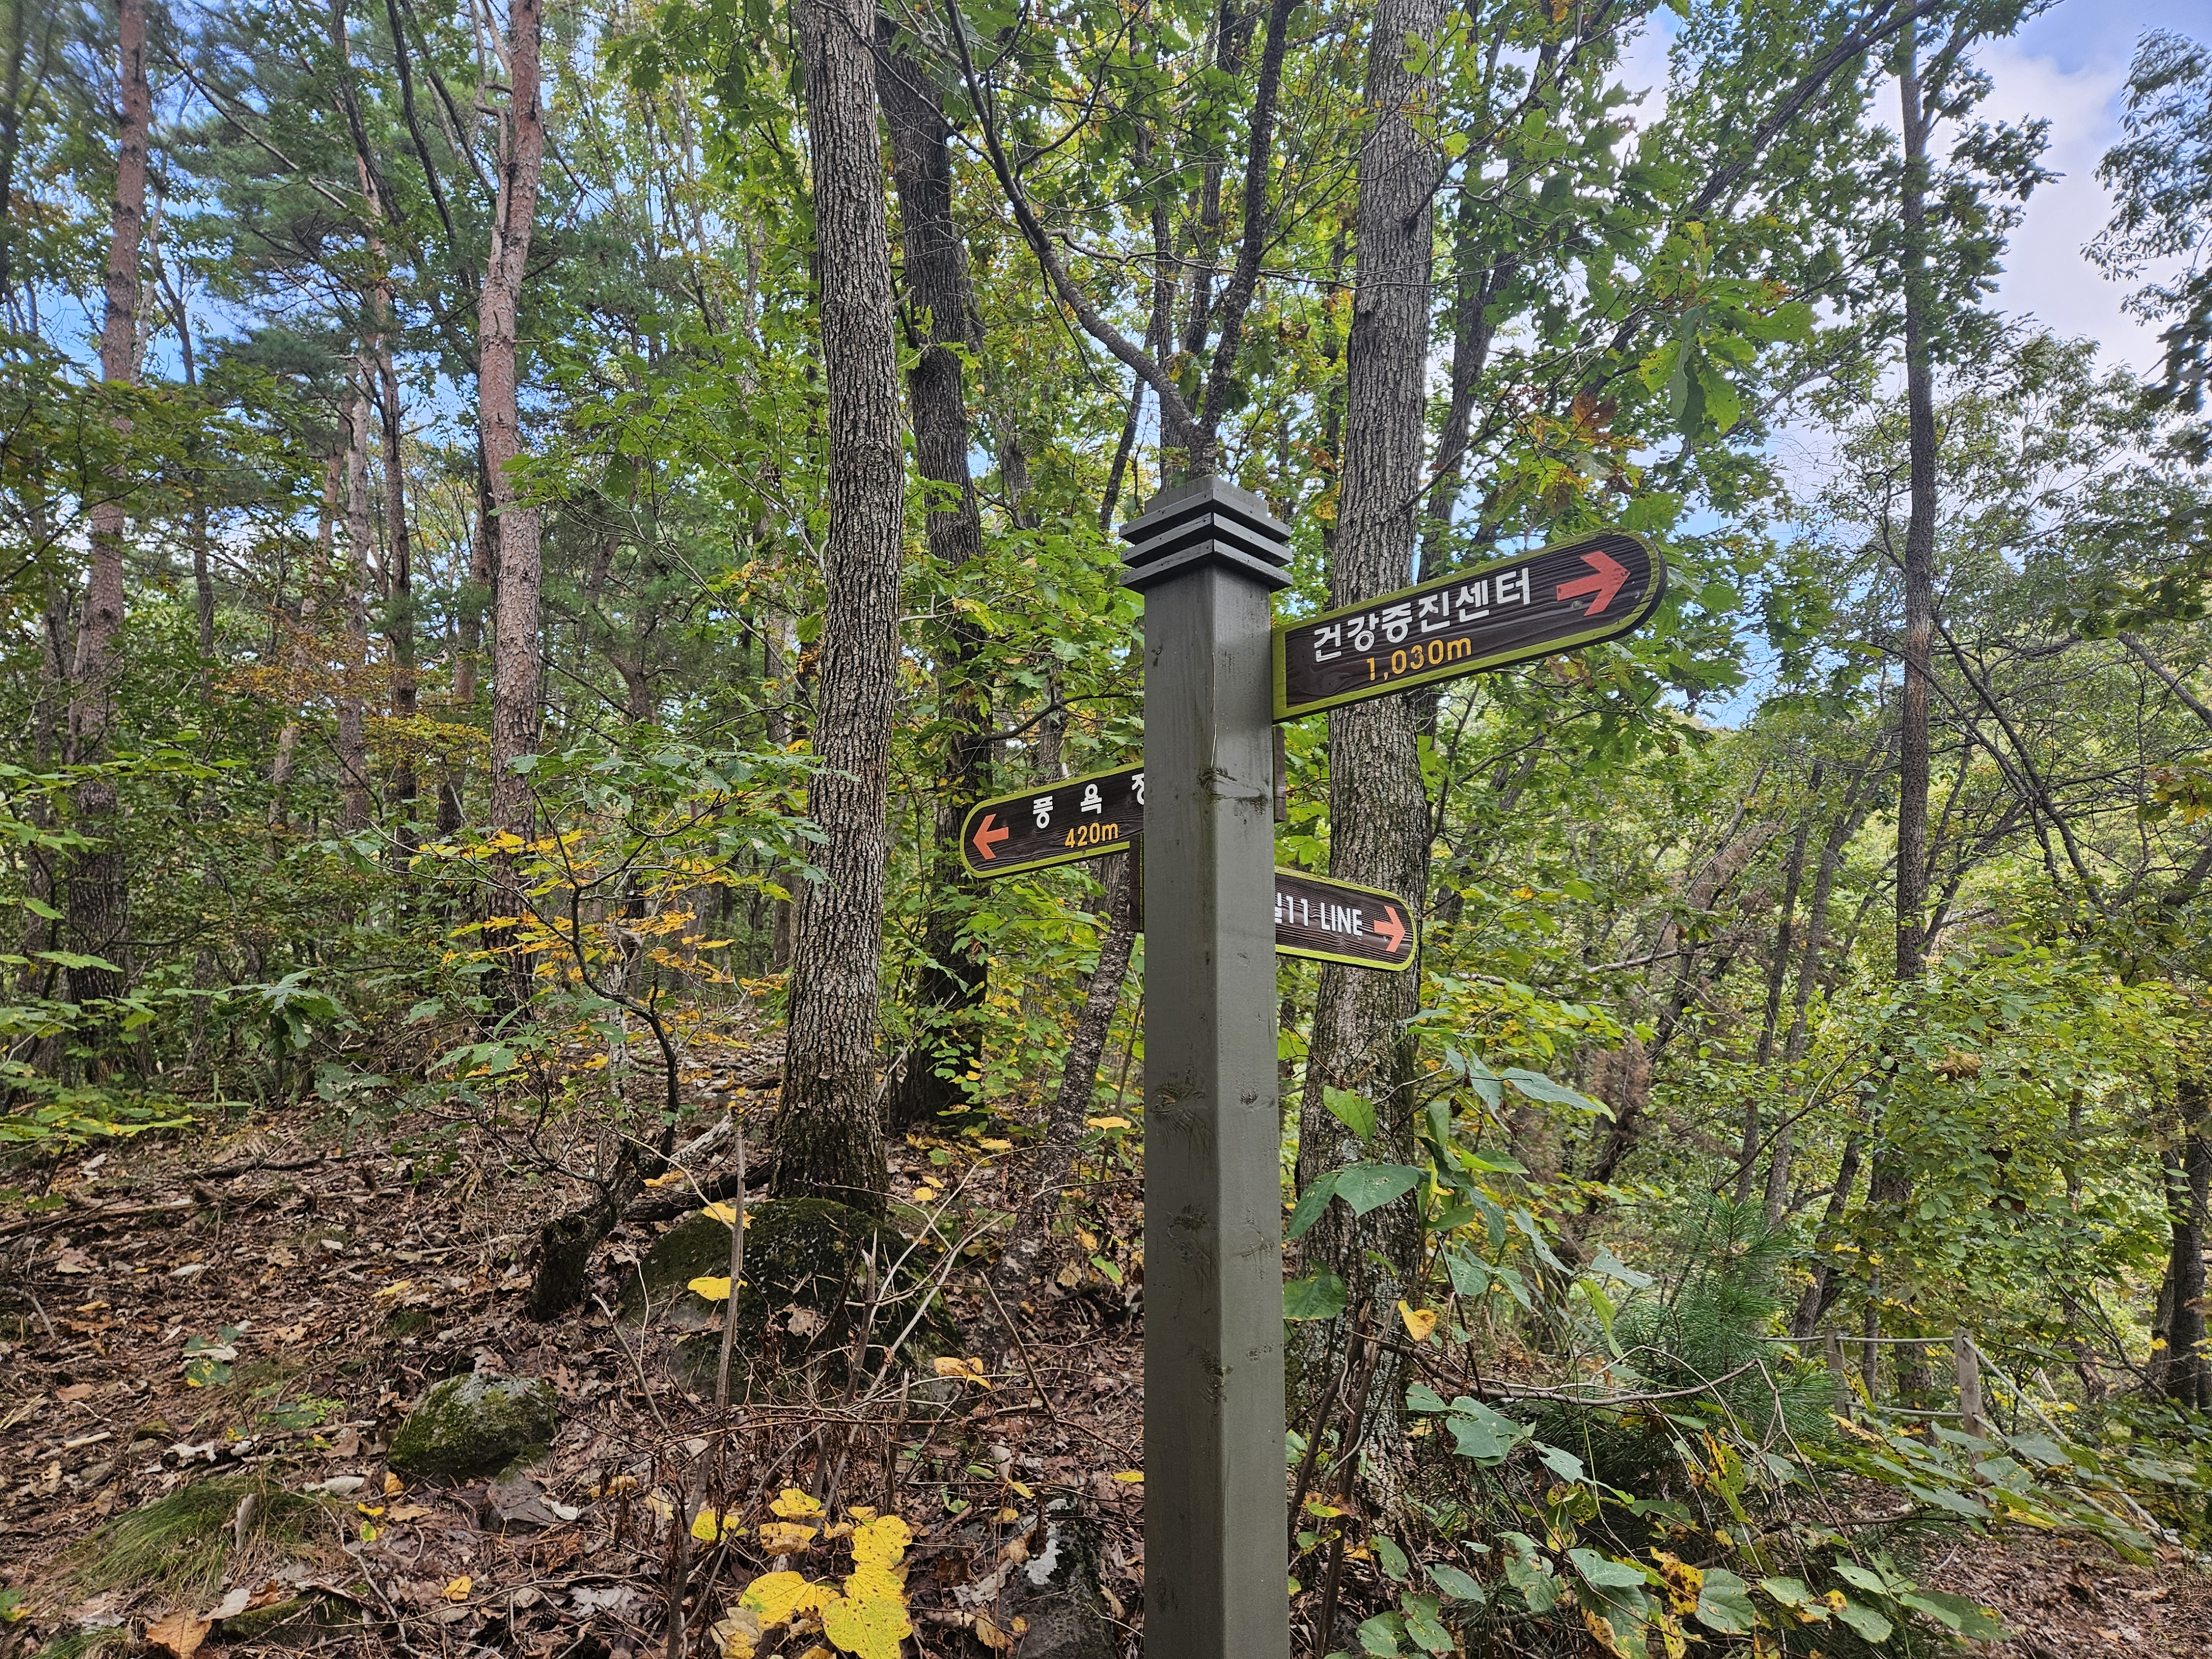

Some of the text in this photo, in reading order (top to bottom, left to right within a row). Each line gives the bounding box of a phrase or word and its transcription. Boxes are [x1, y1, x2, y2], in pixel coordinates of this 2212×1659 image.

[1313, 568, 1530, 662] 건강증진센터
[1366, 638, 1472, 681] 1,030m
[1065, 822, 1119, 848] 420m
[1321, 902, 1363, 936] LINE
